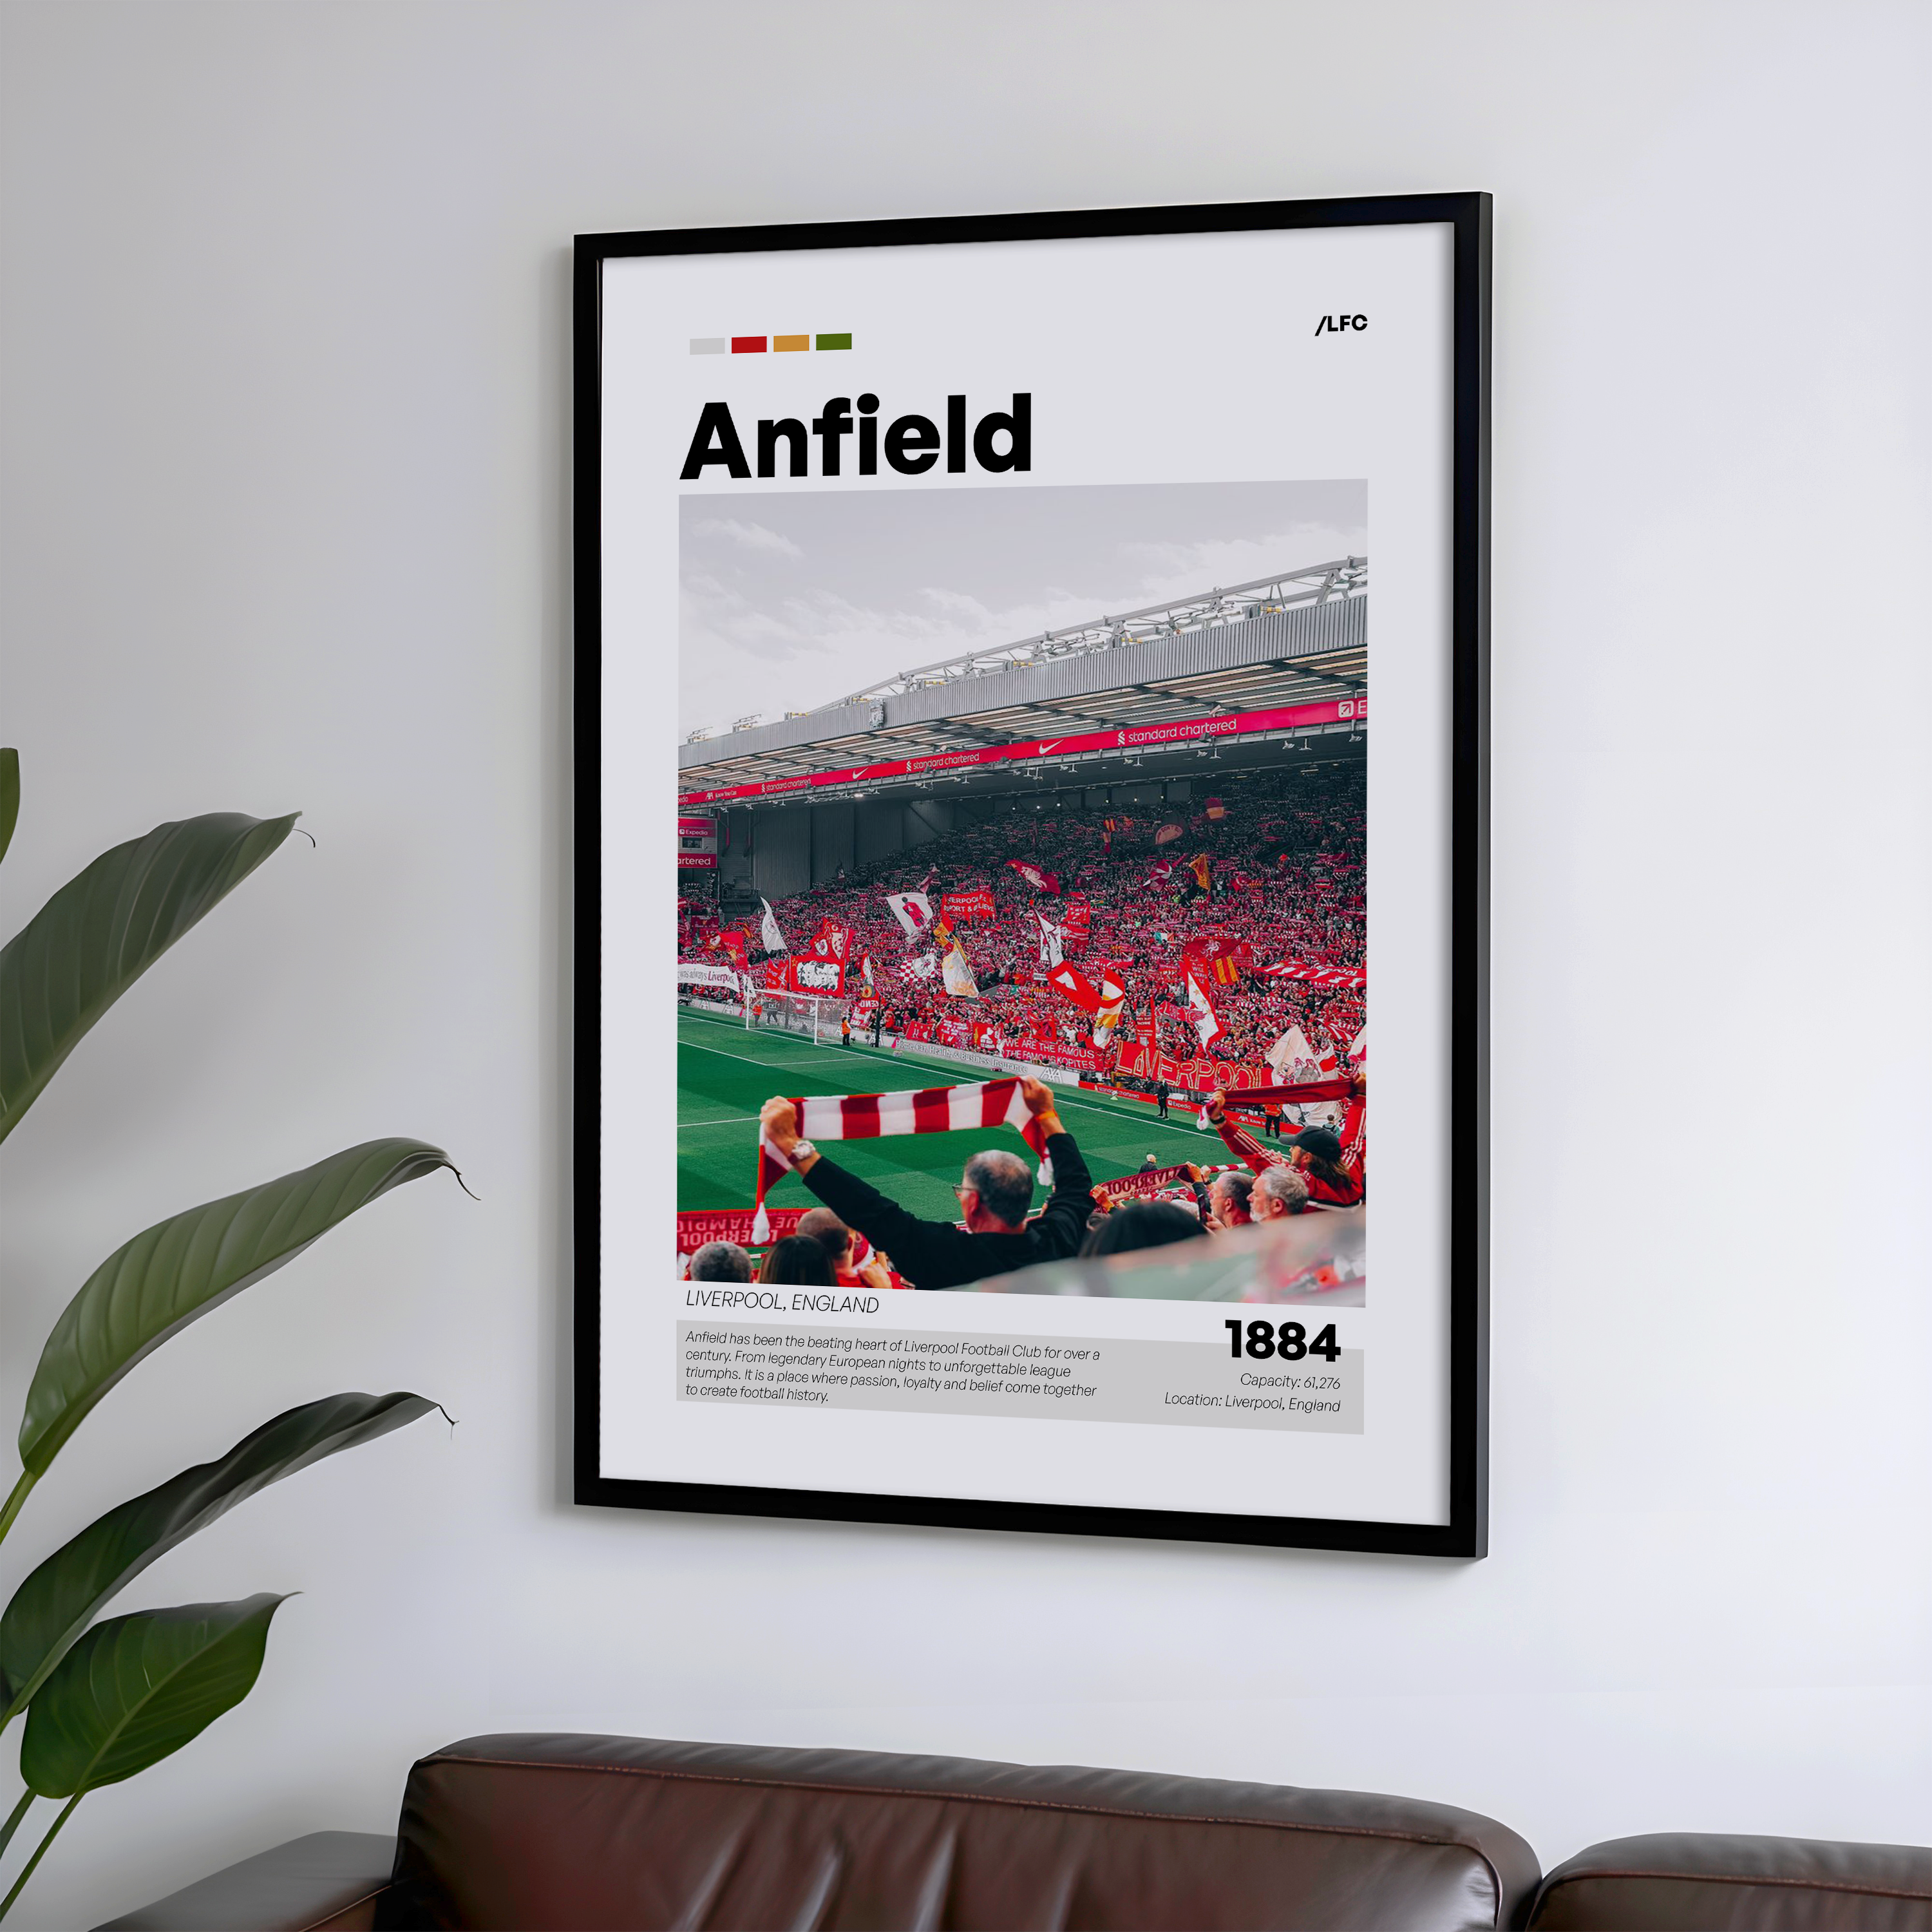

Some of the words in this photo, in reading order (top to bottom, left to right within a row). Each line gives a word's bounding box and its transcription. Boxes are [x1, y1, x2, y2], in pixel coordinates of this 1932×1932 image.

[1314, 314, 1368, 337] /LFC
[679, 393, 1032, 480] Anfield
[1128, 726, 1177, 743] standard
[1179, 718, 1236, 736] chartered
[913, 758, 943, 770] standard
[944, 753, 980, 765] chartered
[766, 781, 788, 791] standard
[788, 778, 811, 788] chartered
[896, 1038, 914, 1050] Home,
[915, 1042, 927, 1053] Car,
[929, 1045, 953, 1058] Health,
[961, 1052, 990, 1065] Business
[992, 1058, 1028, 1074] Insurance
[1005, 1038, 1019, 1048] WE
[1021, 1039, 1037, 1050] ARE
[1039, 1043, 1056, 1053] THE
[1057, 1044, 1095, 1059] FAMOUS
[1005, 1050, 1022, 1059] THE
[1057, 1056, 1096, 1070] KOPITES
[1040, 1067, 1063, 1081] AXA
[1173, 1102, 1191, 1110] Expedia
[680, 1229, 778, 1246] LERPOOL
[687, 1290, 786, 1312] LIVERPOOL,
[791, 1294, 879, 1313] ENGLAND
[685, 1331, 728, 1344] Anfield
[729, 1332, 750, 1345] has
[753, 1333, 782, 1346] been
[785, 1335, 805, 1347] the
[807, 1336, 853, 1352] beating
[855, 1338, 887, 1351] heart
[889, 1340, 903, 1352] of
[904, 1340, 959, 1356] Liverpool
[961, 1342, 1010, 1356] Football
[1012, 1344, 1041, 1358] Club
[1044, 1346, 1063, 1359] for
[1064, 1350, 1091, 1360] over
[1092, 1350, 1100, 1361] a
[1225, 1319, 1341, 1362] 1884
[686, 1349, 732, 1365] century.
[735, 1350, 766, 1363] From
[768, 1352, 828, 1368] legendary
[829, 1354, 886, 1370] European
[888, 1358, 926, 1373] nights
[929, 1359, 942, 1372] to
[944, 1360, 1027, 1376] unforgettable
[1029, 1363, 1071, 1379] league
[686, 1366, 741, 1381] triumphs.
[744, 1368, 753, 1380] It
[755, 1369, 764, 1381] is
[767, 1372, 774, 1381] a
[776, 1370, 809, 1385] place
[811, 1372, 848, 1385] where
[849, 1375, 900, 1388] passion,
[903, 1376, 942, 1392] loyalty
[943, 1378, 967, 1390] and
[969, 1379, 1004, 1392] belief
[1005, 1383, 1041, 1394] come
[1043, 1383, 1097, 1398] together
[1240, 1372, 1302, 1390] Capacity:
[1303, 1376, 1341, 1390] 61,276
[685, 1384, 698, 1396] to
[700, 1385, 737, 1397] create
[740, 1385, 785, 1399] football
[786, 1388, 828, 1405] history.
[1164, 1392, 1222, 1406] Location:
[1225, 1394, 1285, 1411] Liverpool,
[1289, 1397, 1341, 1414] England
